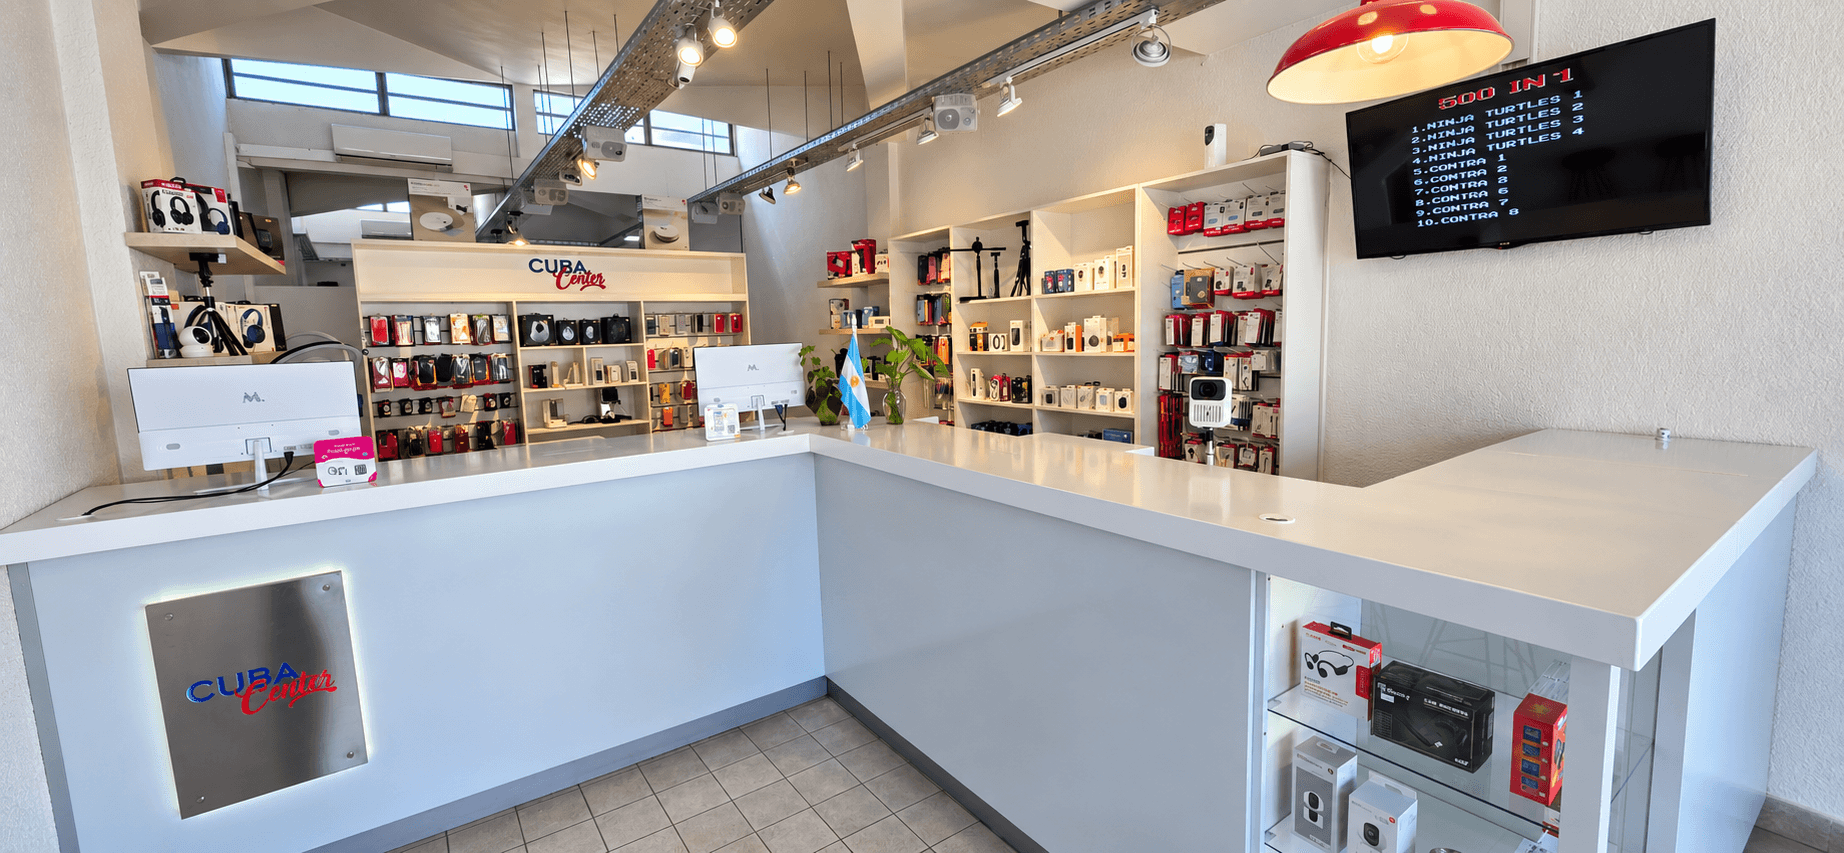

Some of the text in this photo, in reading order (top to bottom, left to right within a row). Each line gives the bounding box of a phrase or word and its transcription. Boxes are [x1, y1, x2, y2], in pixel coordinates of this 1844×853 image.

[1438, 68, 1574, 110] 500 IN 1
[1411, 102, 1584, 144] 2.NINJA TURTLES 2
[1412, 90, 1583, 133] 1.NINJA TURTLES 1
[1412, 115, 1584, 155] 3.NINJA TURTLES 3
[1412, 127, 1585, 165] 4.NINJA TURTLES 4
[1413, 153, 1507, 175] 5.CONTRA 1
[1413, 164, 1508, 186] 6.CONTRA 2
[1414, 179, 1488, 196] 7.CONTRA
[1415, 187, 1509, 207] 8.CONTRA 6
[1416, 198, 1509, 217] 9.CONTRA 7
[1417, 207, 1520, 228] 10.CONTRA 8
[528, 258, 587, 273] CUBA
[552, 266, 606, 291] Center
[186, 662, 301, 703] CUBA
[234, 669, 338, 715] Center
